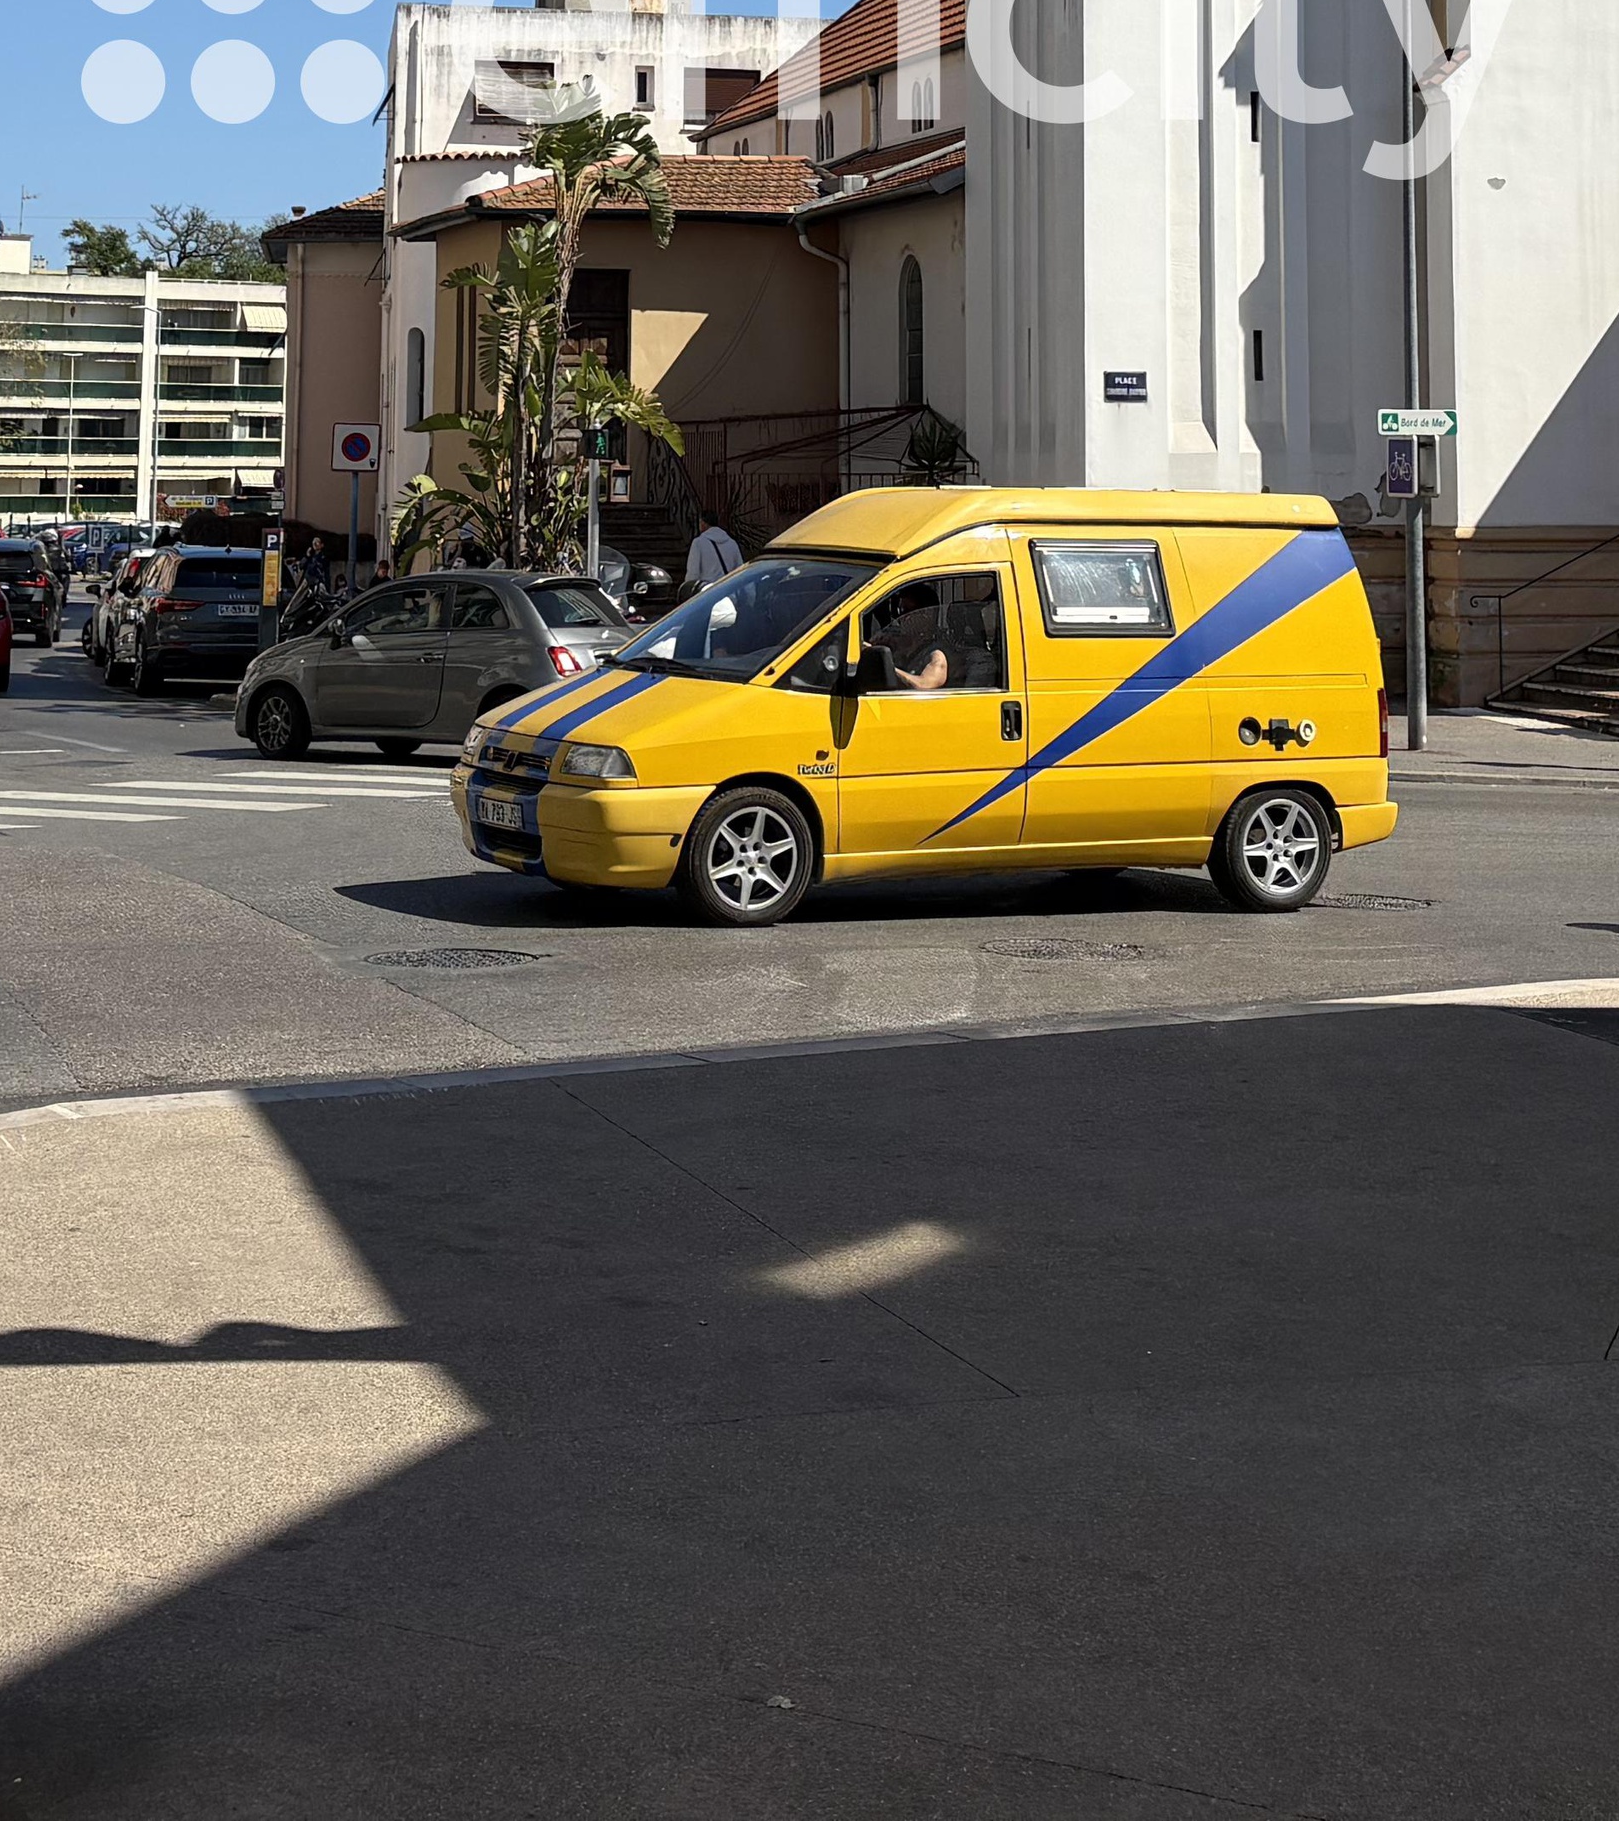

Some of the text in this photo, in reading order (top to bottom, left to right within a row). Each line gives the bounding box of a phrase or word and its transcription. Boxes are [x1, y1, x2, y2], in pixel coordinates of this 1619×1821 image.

[1401, 418, 1446, 427] Bord de Mer
[267, 534, 277, 548] P
